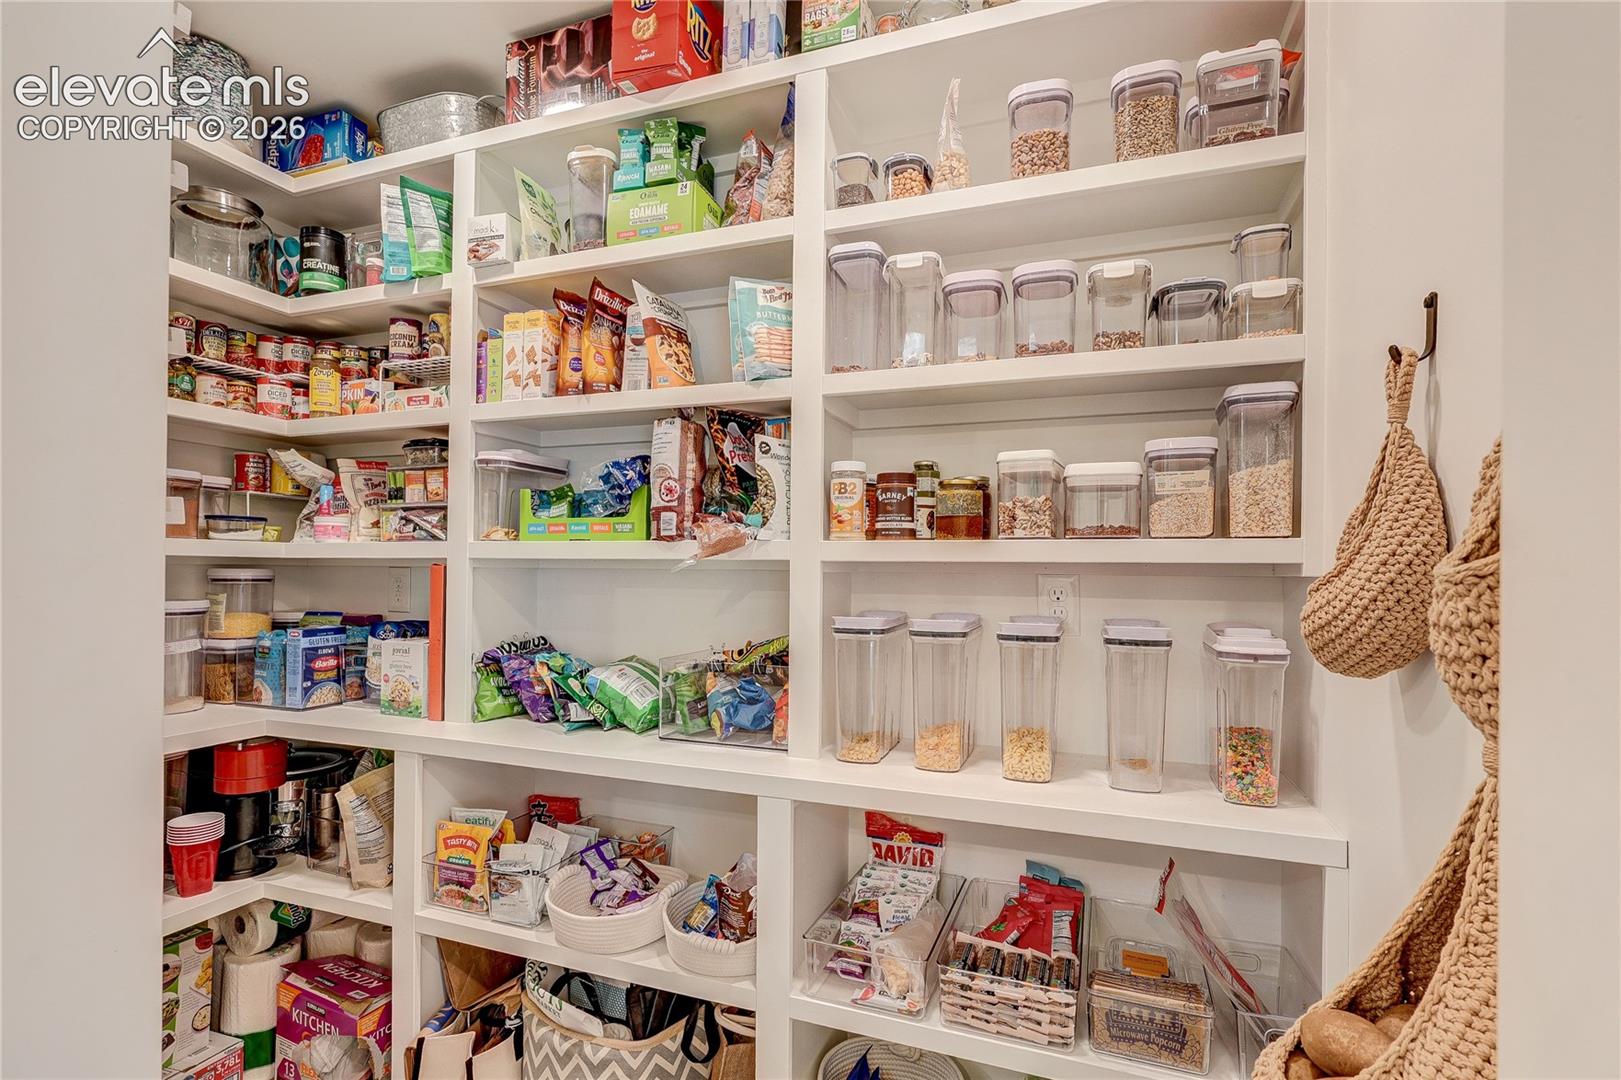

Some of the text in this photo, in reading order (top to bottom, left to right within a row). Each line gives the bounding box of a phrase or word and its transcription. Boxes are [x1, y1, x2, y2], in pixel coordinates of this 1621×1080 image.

[634, 51, 656, 62] original
[527, 56, 537, 94] Fountain
[512, 57, 528, 121] Chocolate
[266, 130, 280, 168] Ziplo
[628, 202, 669, 219] EDAMAME
[302, 261, 340, 274] CREATINE
[389, 333, 417, 343] COCONUT
[390, 341, 415, 350] CREAM
[290, 347, 310, 358] DICED
[313, 366, 336, 378] Zoup!
[267, 388, 288, 399] DICED
[341, 389, 365, 401] PKIN
[832, 481, 857, 496] PB2
[308, 636, 330, 646] GLUTEN
[446, 837, 467, 847] TASTY
[872, 842, 934, 868] DAVID
[319, 962, 384, 989] KITCHEN
[291, 1006, 340, 1037] KITCHEN
[368, 1023, 392, 1041] KITC
[1110, 1027, 1182, 1051] Microwave Popcorn
[284, 1061, 296, 1078] 13
